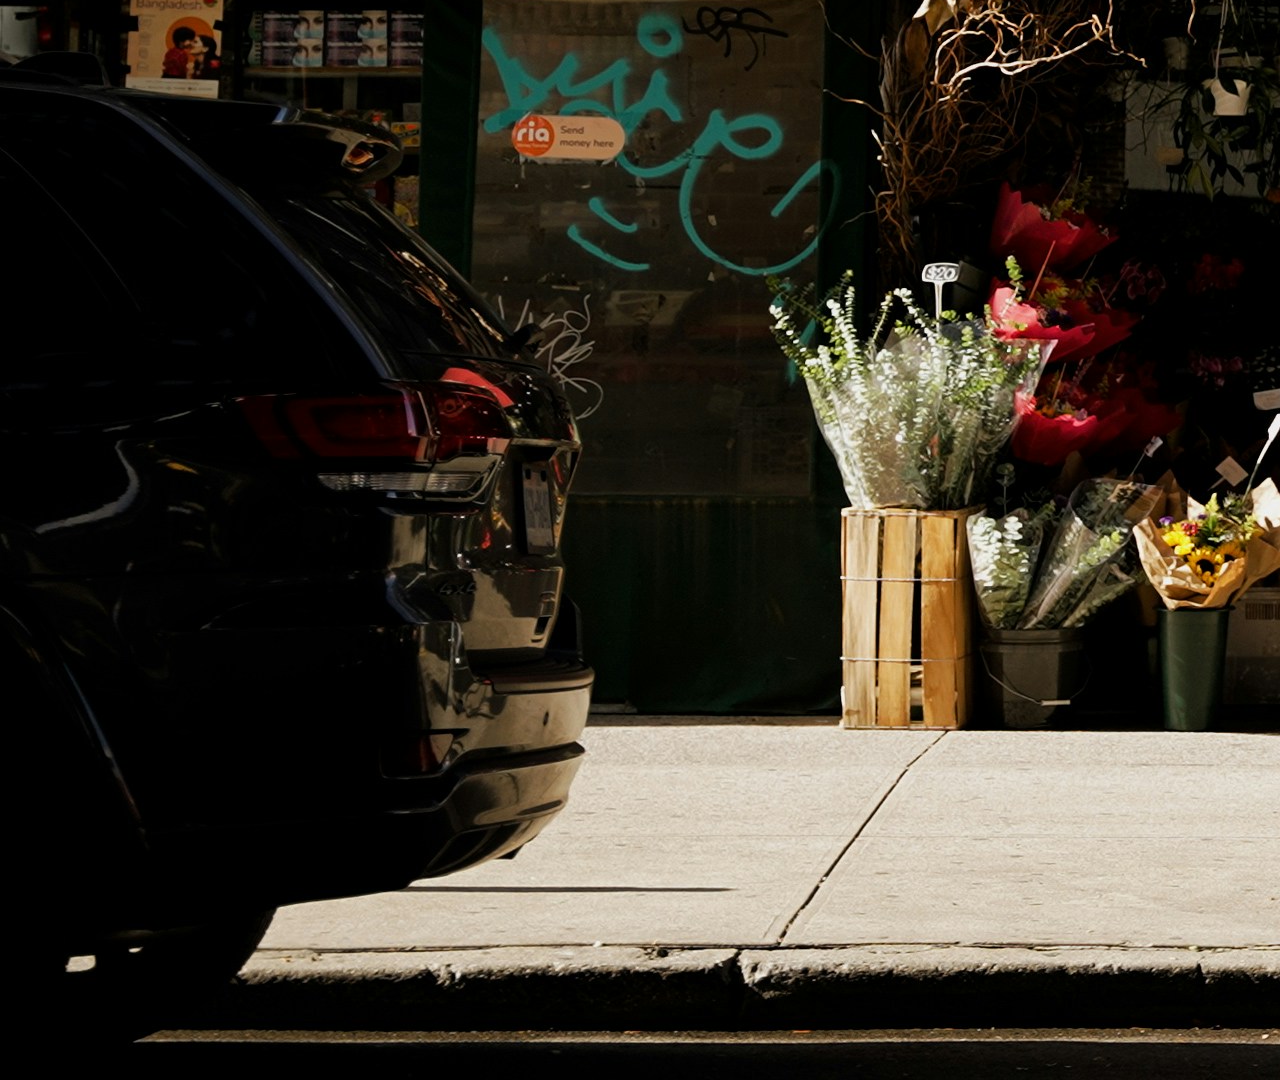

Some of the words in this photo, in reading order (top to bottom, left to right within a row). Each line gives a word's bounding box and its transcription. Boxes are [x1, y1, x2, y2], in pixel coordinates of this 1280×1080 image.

[516, 120, 550, 143] ria
[560, 125, 585, 135] Send
[560, 139, 592, 148] money
[593, 139, 615, 148] here
[926, 265, 956, 280] $20
